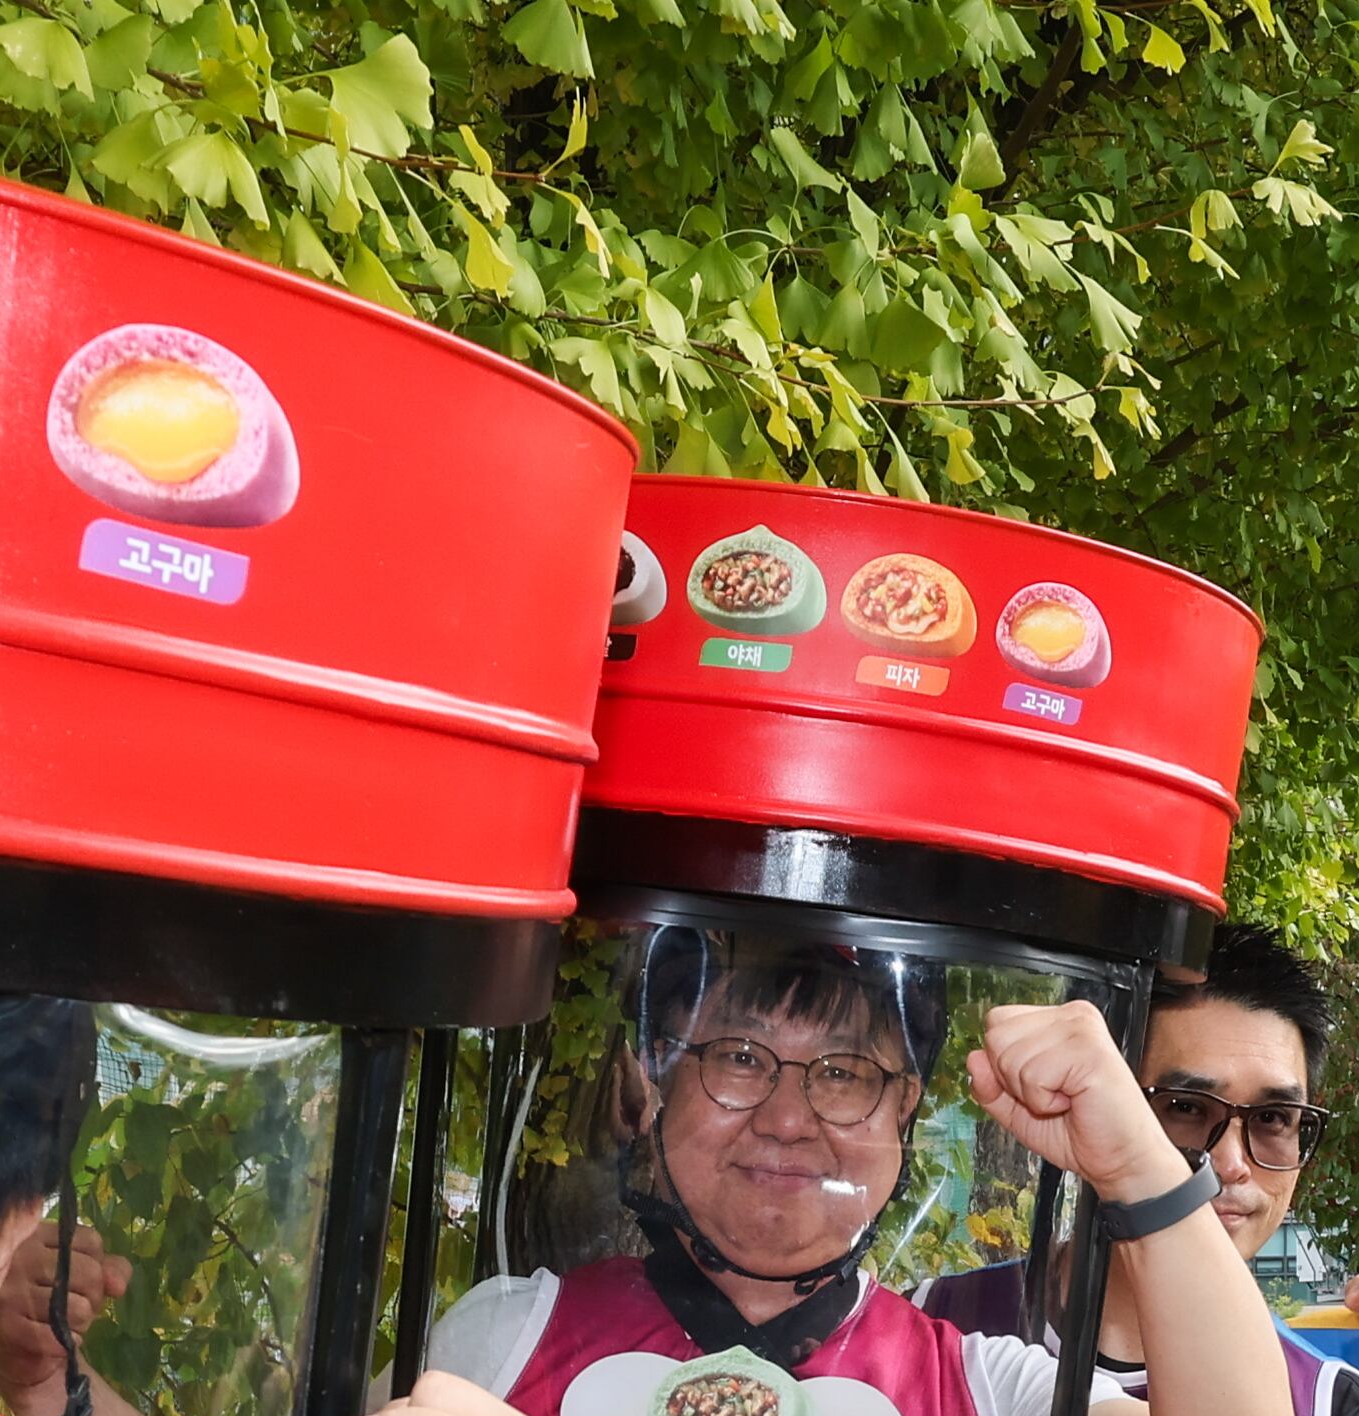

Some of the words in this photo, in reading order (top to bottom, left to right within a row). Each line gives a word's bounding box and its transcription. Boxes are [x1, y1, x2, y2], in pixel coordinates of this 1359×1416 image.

[119, 537, 214, 594] 고구마
[727, 643, 762, 668] 야채
[885, 664, 921, 689] 피자
[1020, 690, 1066, 720] 고구마
